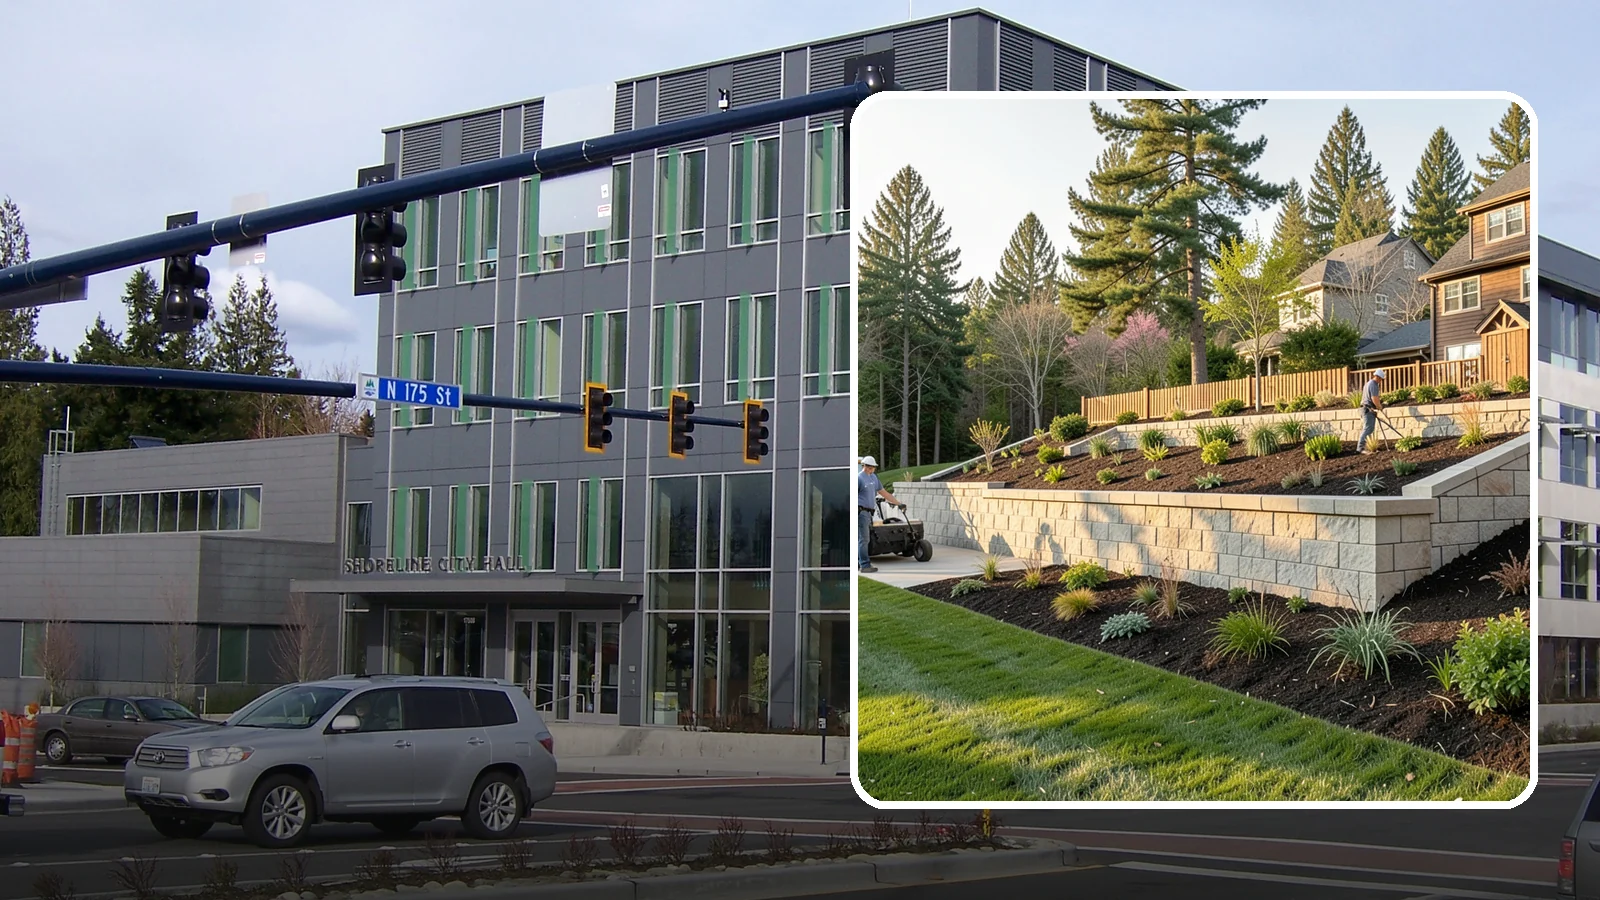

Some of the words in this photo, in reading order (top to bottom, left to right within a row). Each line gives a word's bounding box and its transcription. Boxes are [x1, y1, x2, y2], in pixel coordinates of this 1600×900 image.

[387, 380, 396, 400] N
[405, 382, 427, 403] 175
[436, 386, 451, 406] St
[344, 557, 432, 574] SHORELINE
[438, 556, 475, 572] CITY
[483, 555, 525, 571] HALL
